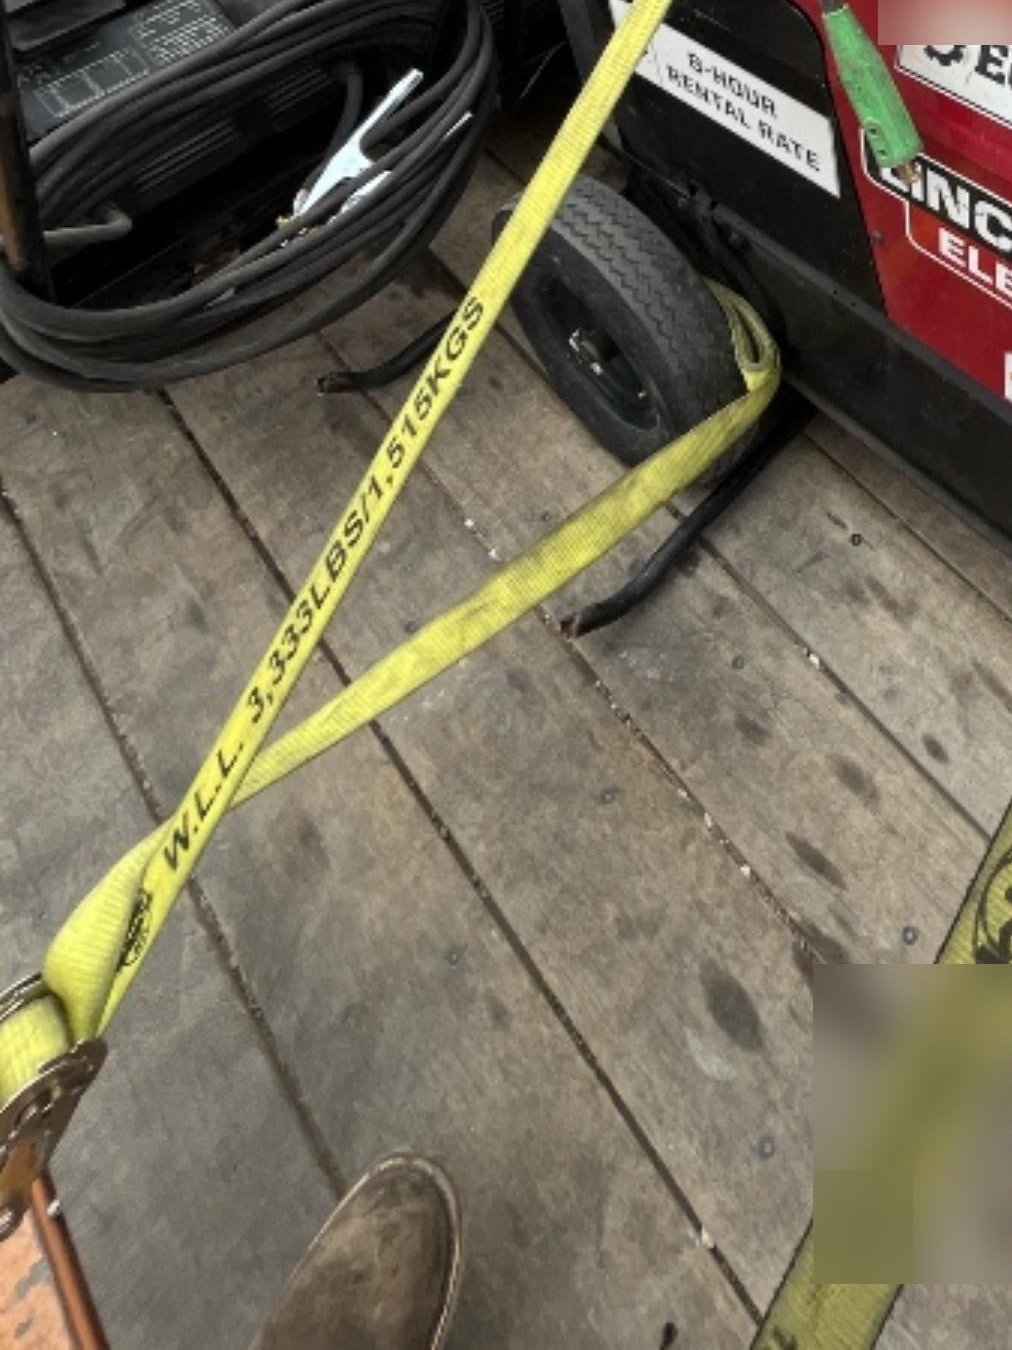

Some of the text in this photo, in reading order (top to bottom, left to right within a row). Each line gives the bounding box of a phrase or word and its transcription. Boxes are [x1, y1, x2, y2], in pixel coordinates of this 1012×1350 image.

[667, 65, 820, 172] RENTAL RATE
[246, 295, 484, 724] 3,333LBS/1,515KGS
